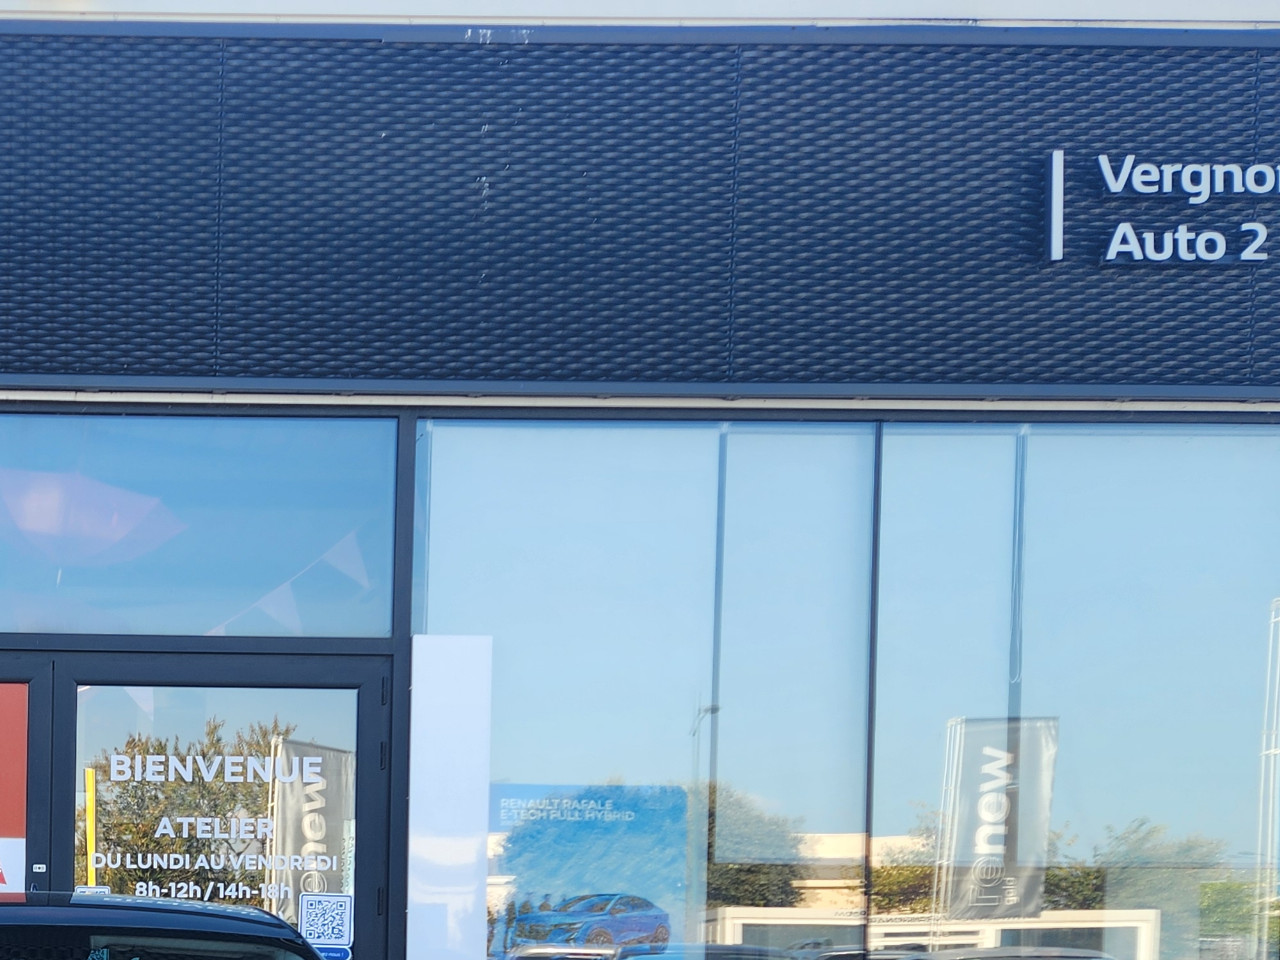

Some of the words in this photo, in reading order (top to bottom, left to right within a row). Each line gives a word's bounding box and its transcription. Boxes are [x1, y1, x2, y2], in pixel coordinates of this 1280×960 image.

[1106, 222, 1226, 261] Auto
[1240, 222, 1268, 260] 2
[110, 755, 322, 783] BIENVENUE
[500, 798, 560, 809] RENAULT
[563, 799, 613, 810] RAFALE
[500, 809, 546, 820] E-TECH
[550, 810, 583, 820] FULL
[586, 810, 635, 821] HYBRID
[154, 817, 274, 838] ATELIER
[969, 746, 1014, 906] renew
[91, 853, 121, 868] DU
[126, 853, 190, 870] LUNDI
[194, 854, 224, 870] AU
[231, 854, 337, 871] VENDREDI
[135, 882, 201, 898] 8h-12h
[217, 883, 291, 899] 14h-18h
